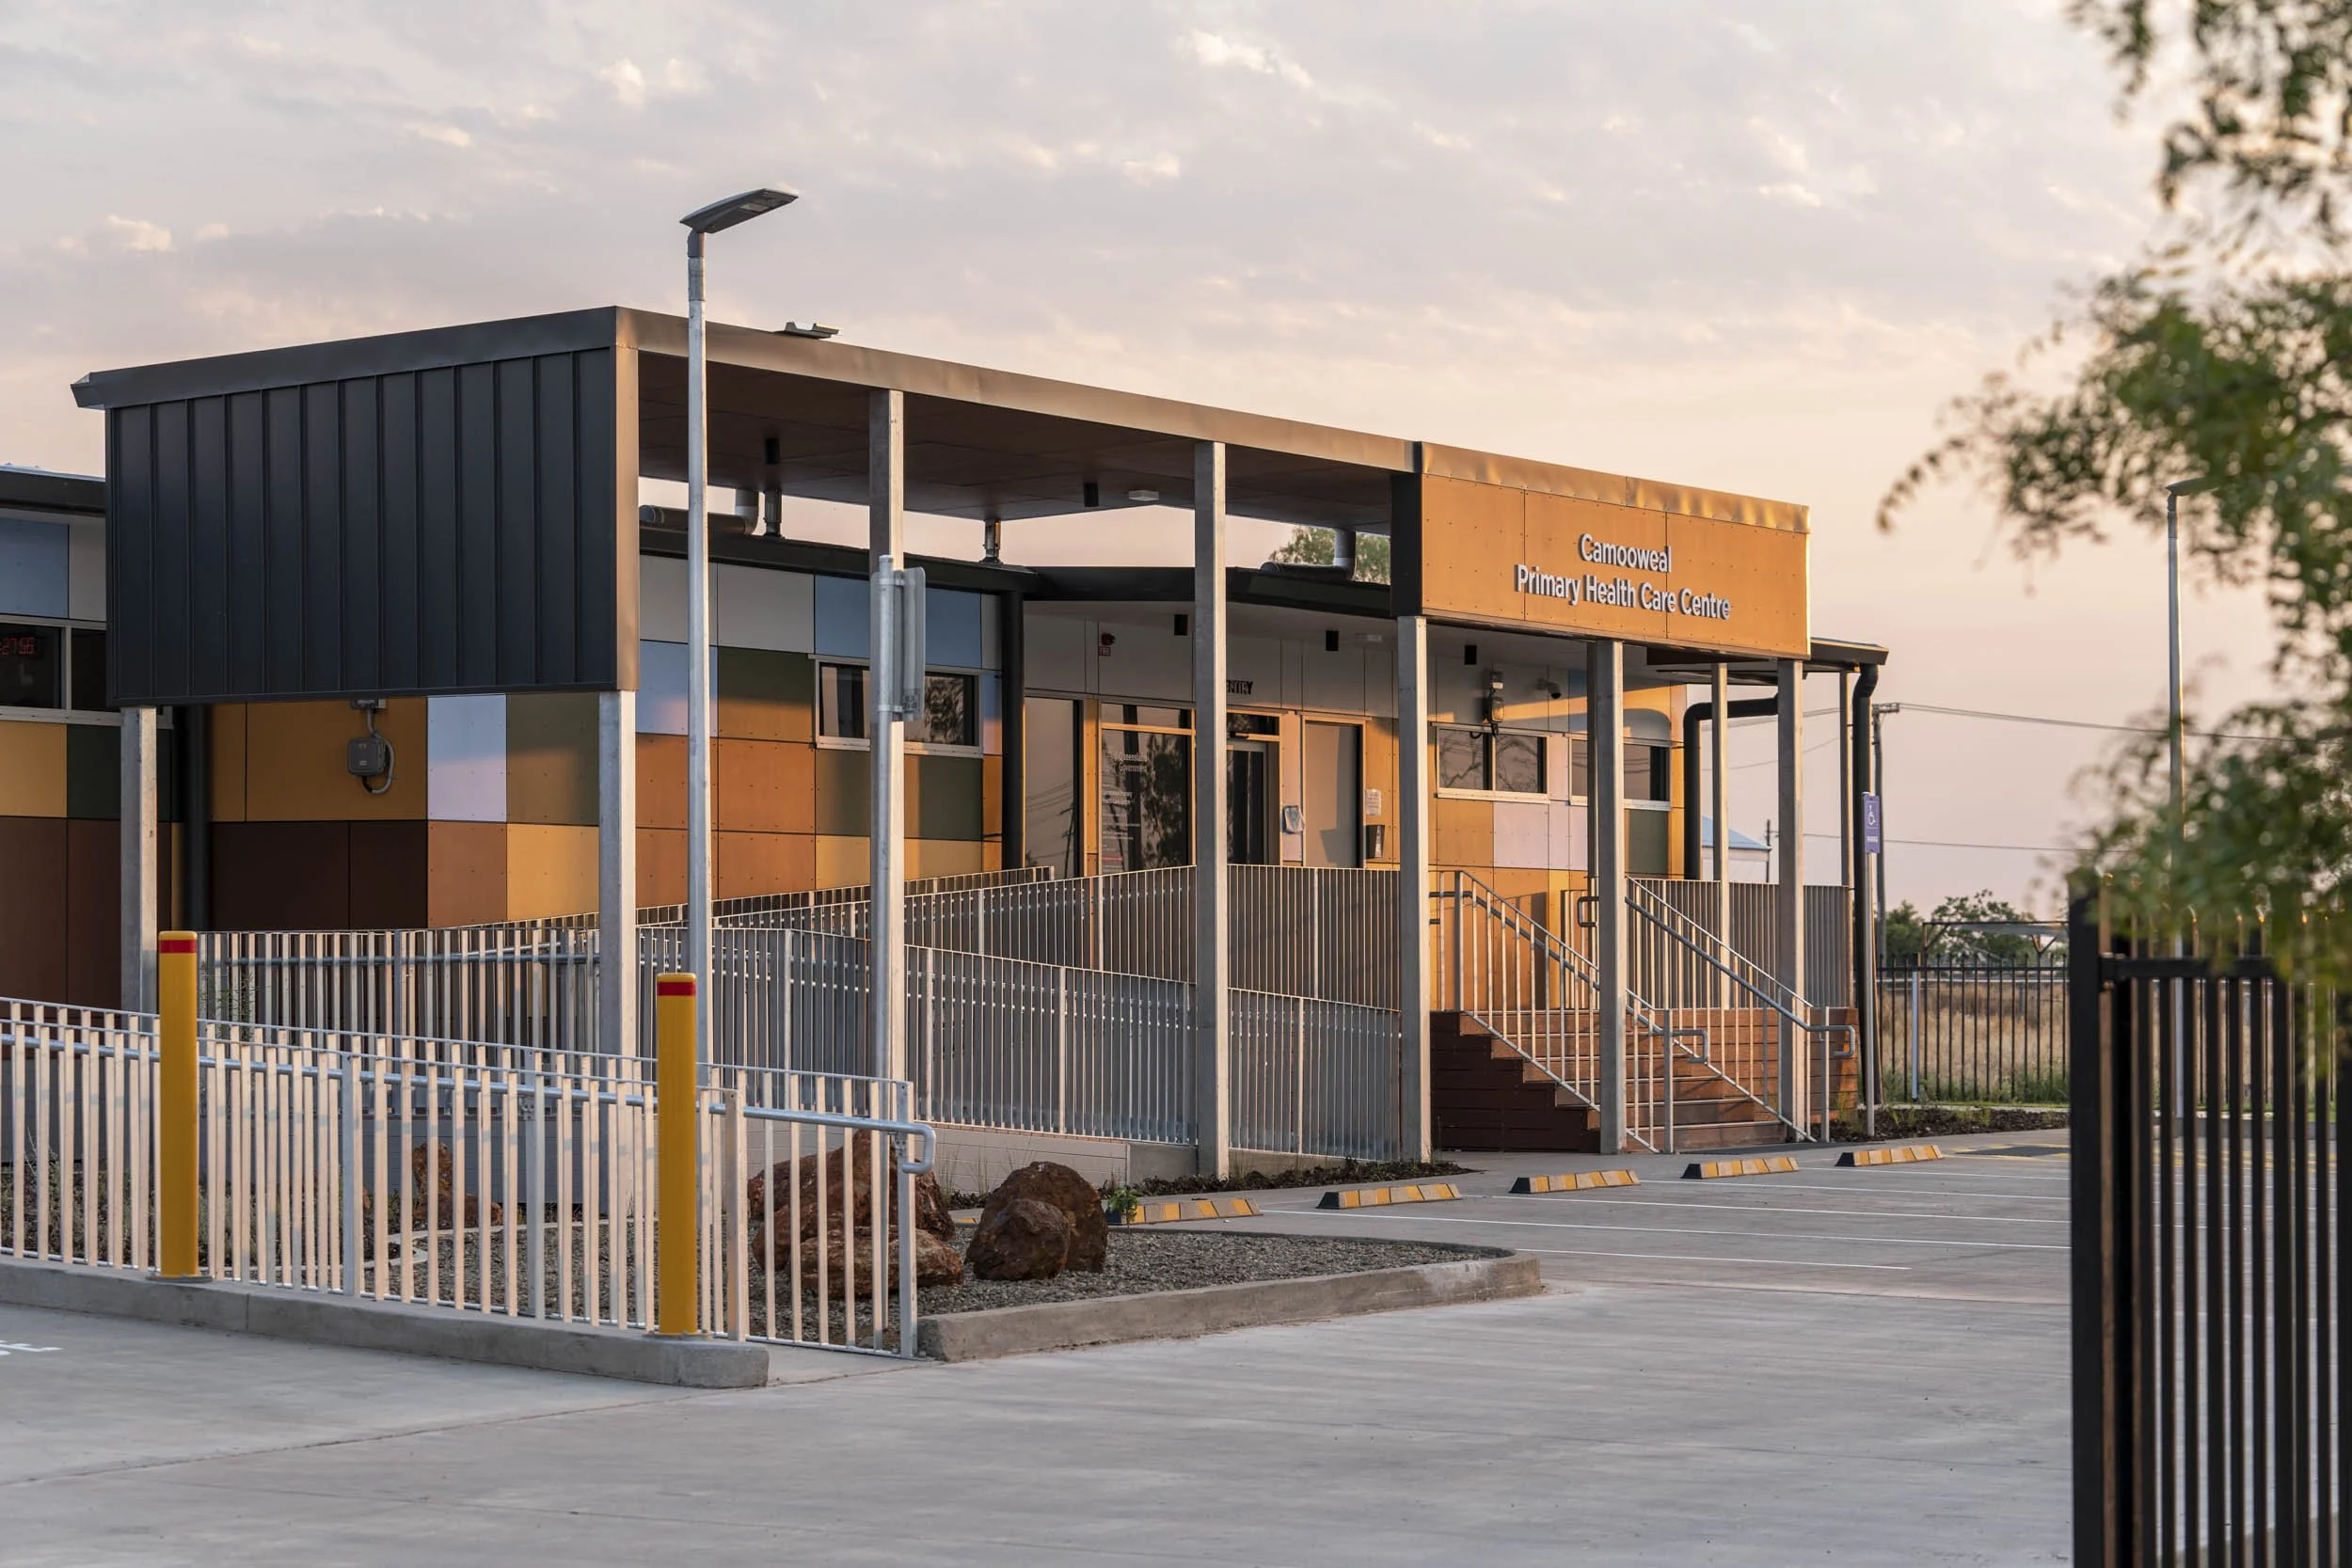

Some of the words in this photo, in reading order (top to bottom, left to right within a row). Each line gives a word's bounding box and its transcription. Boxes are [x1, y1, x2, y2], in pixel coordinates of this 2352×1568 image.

[1579, 533, 1671, 573] Camooweal
[1515, 564, 1581, 605] Primary
[1583, 575, 1636, 608] Health
[1639, 581, 1677, 612] Care
[1679, 588, 1731, 620] Centre
